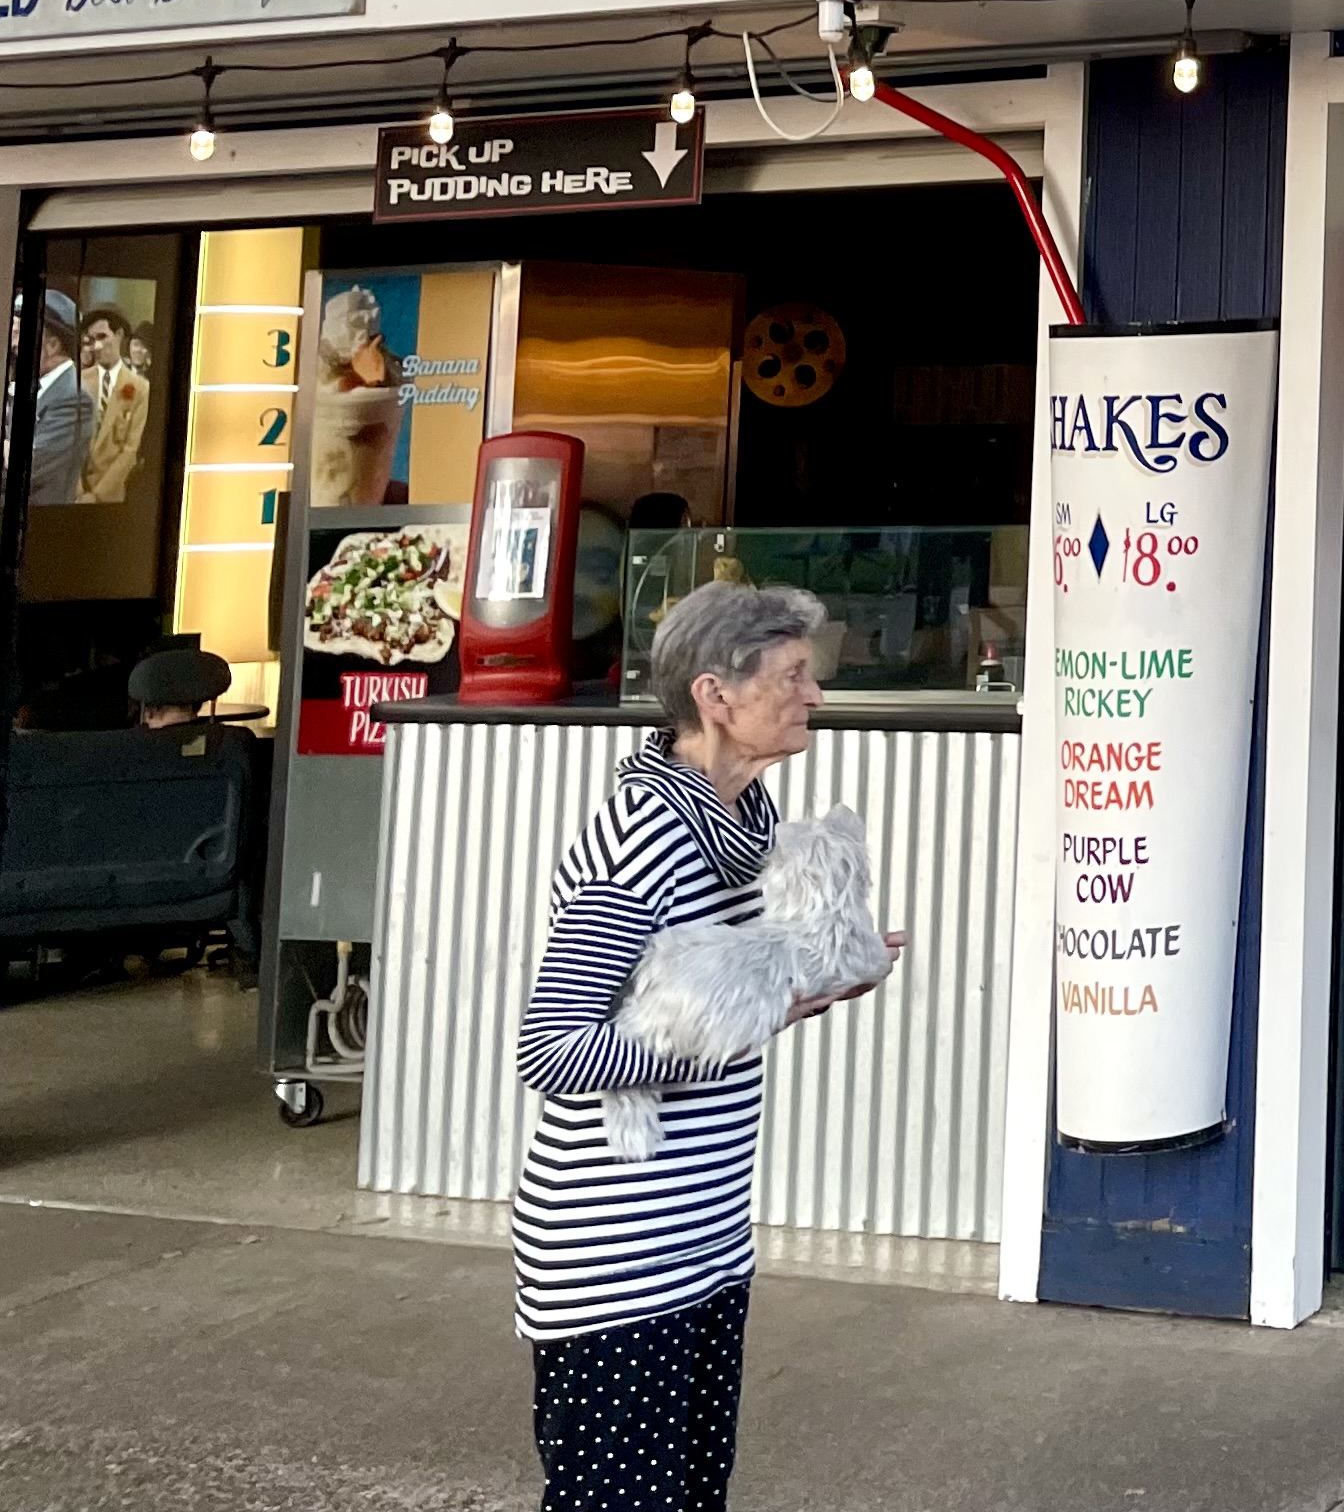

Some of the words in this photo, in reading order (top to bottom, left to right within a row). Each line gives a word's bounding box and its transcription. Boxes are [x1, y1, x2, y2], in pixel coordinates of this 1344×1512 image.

[391, 144, 466, 171] PICK
[468, 138, 514, 164] UP
[387, 172, 532, 205] PUDDING
[541, 166, 633, 195] HERE
[262, 329, 290, 368] 3
[402, 355, 479, 377] Banana
[398, 382, 480, 411] Pudding
[258, 407, 288, 446] 2
[1050, 392, 1229, 474] HAKES
[259, 488, 277, 524] 1
[1055, 501, 1071, 525] SM
[1146, 501, 1178, 526] LG
[1055, 648, 1193, 680] EMON-LIME
[342, 675, 426, 708] TURKISH
[1064, 687, 1154, 719] RICKEY
[1061, 740, 1162, 772] ORANGE
[1064, 779, 1154, 810] DREAM
[1063, 833, 1149, 866] PURPLE
[1076, 872, 1134, 904] COW
[1061, 980, 1158, 1016] VANILLA
